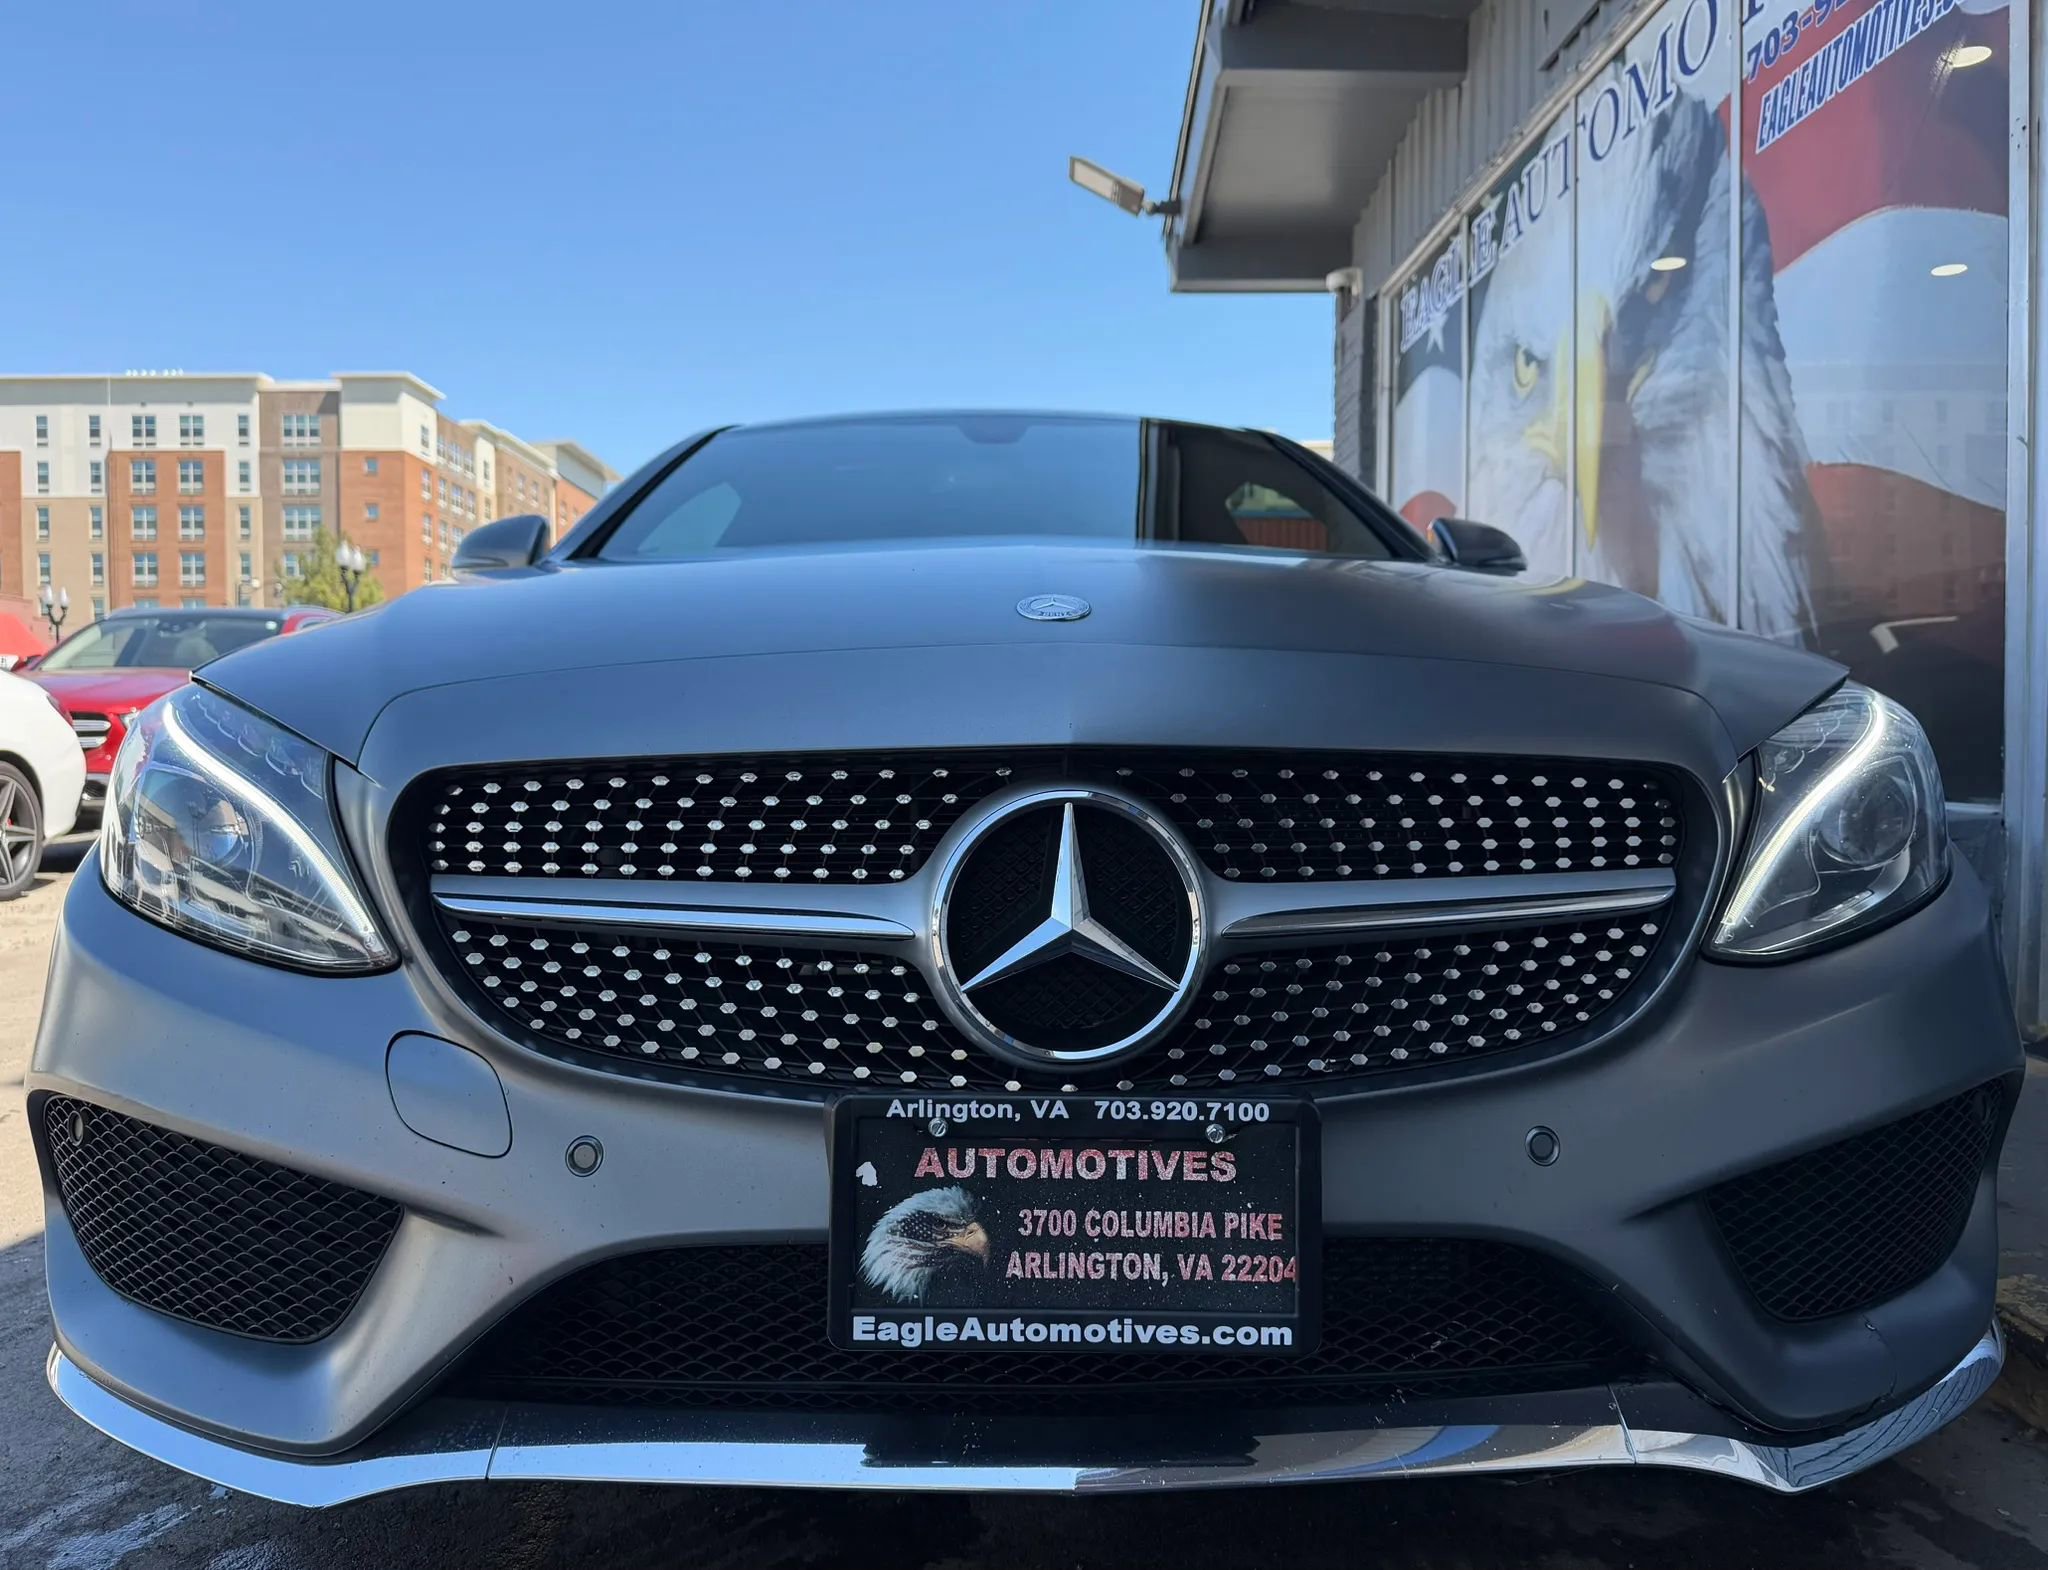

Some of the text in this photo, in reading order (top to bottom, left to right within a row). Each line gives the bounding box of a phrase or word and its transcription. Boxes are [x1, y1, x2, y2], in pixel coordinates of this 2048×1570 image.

[1747, 0, 1850, 83] 703-9
[1400, 0, 1763, 353] EAGLE AUTOMO
[886, 1099, 1270, 1123] Arlington, VA 703.920.7100
[914, 1147, 1237, 1182] AUTOMOTIVES
[1018, 1209, 1283, 1240] 3700 COLUMBIA PIKE
[1005, 1251, 1297, 1287] ARLINGTON, VA 22204
[852, 1316, 1293, 1347] EagleAutomotives.com
